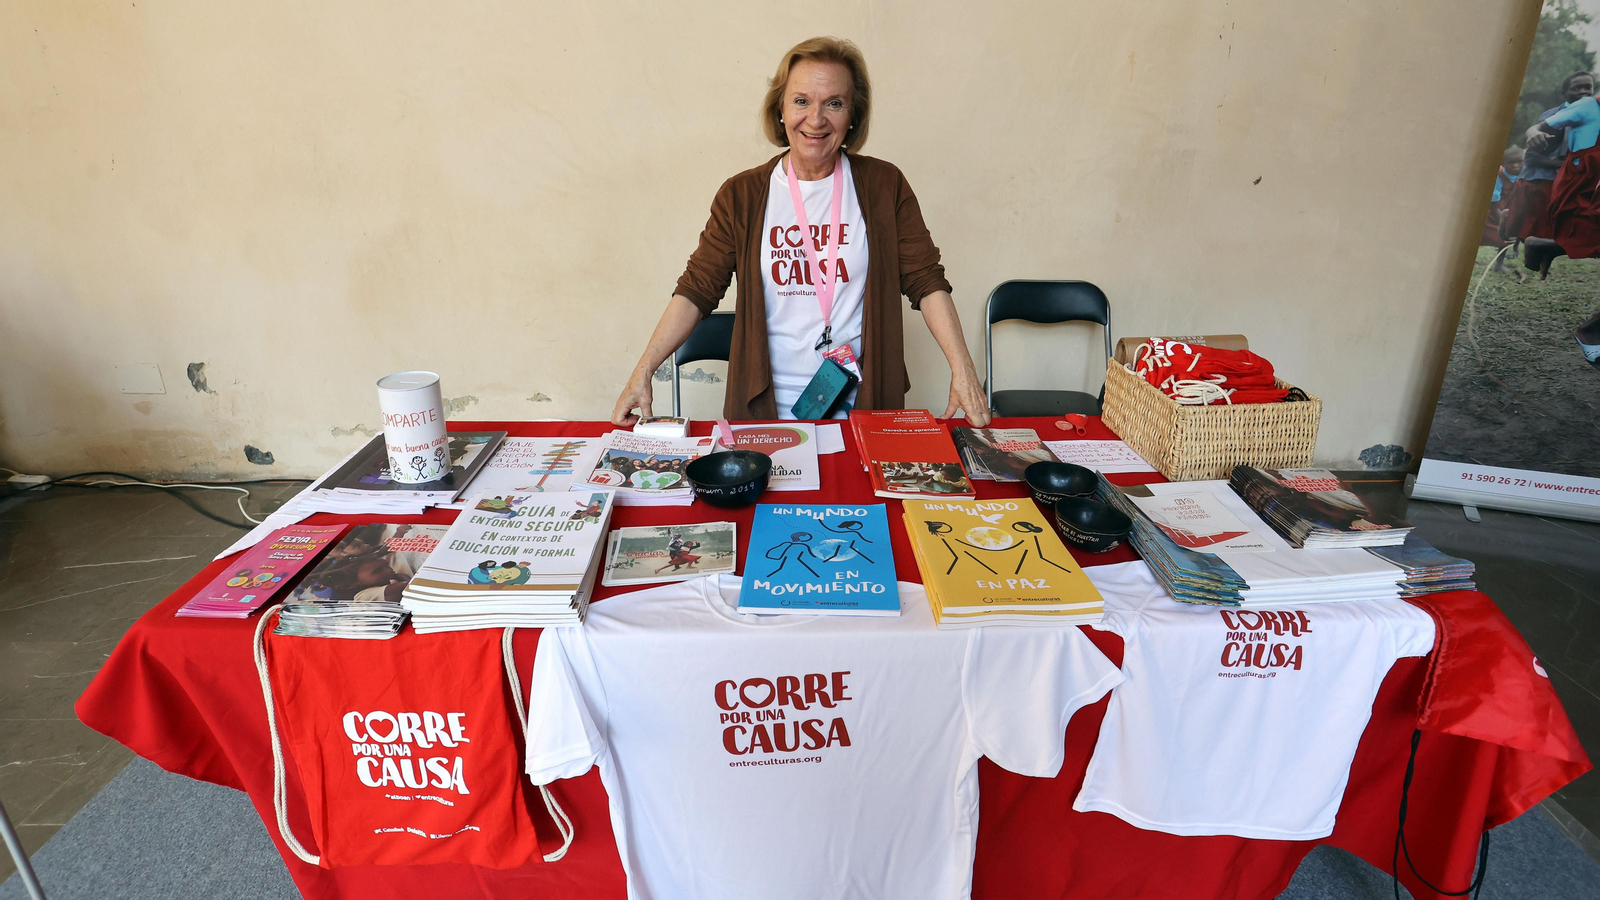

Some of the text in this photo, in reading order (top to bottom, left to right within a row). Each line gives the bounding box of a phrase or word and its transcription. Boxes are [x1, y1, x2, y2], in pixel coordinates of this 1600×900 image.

[771, 248, 807, 260] POR UN
[381, 408, 437, 428] OMPARTE
[752, 436, 792, 444] DERECHO
[405, 442, 430, 454] buena
[1461, 472, 1474, 481] 91
[1476, 474, 1496, 483] 590
[1498, 477, 1511, 485] 26
[1513, 478, 1526, 487] 72
[730, 482, 755, 494] 2019
[1174, 498, 1194, 506] NO
[517, 505, 556, 517] GUÍA
[796, 508, 868, 520] MUNDO
[946, 502, 1020, 517] MUNDO
[470, 516, 584, 532] ENTORNO SEGURO
[277, 536, 312, 544] FERIA
[480, 531, 498, 542] EN
[550, 535, 564, 543] DE
[449, 540, 520, 556] EDUCACIÓN
[534, 548, 576, 557] FORMAL
[835, 570, 859, 580] EN
[754, 580, 886, 596] MOVIMIENTO
[976, 578, 1051, 590] EN PAZ
[1220, 610, 1312, 637] CORRE
[1226, 632, 1268, 644] POR UNA
[1220, 642, 1303, 670] CAUSA
[1218, 671, 1276, 679] entreculturas.org
[714, 671, 852, 711] CORRE
[720, 708, 786, 724] POR UNA
[342, 711, 470, 748] CORRE
[722, 717, 852, 756] CAUSA
[352, 744, 412, 758] POR UNA
[729, 756, 822, 768] entreculturas.org
[356, 756, 470, 794] CAUSA
